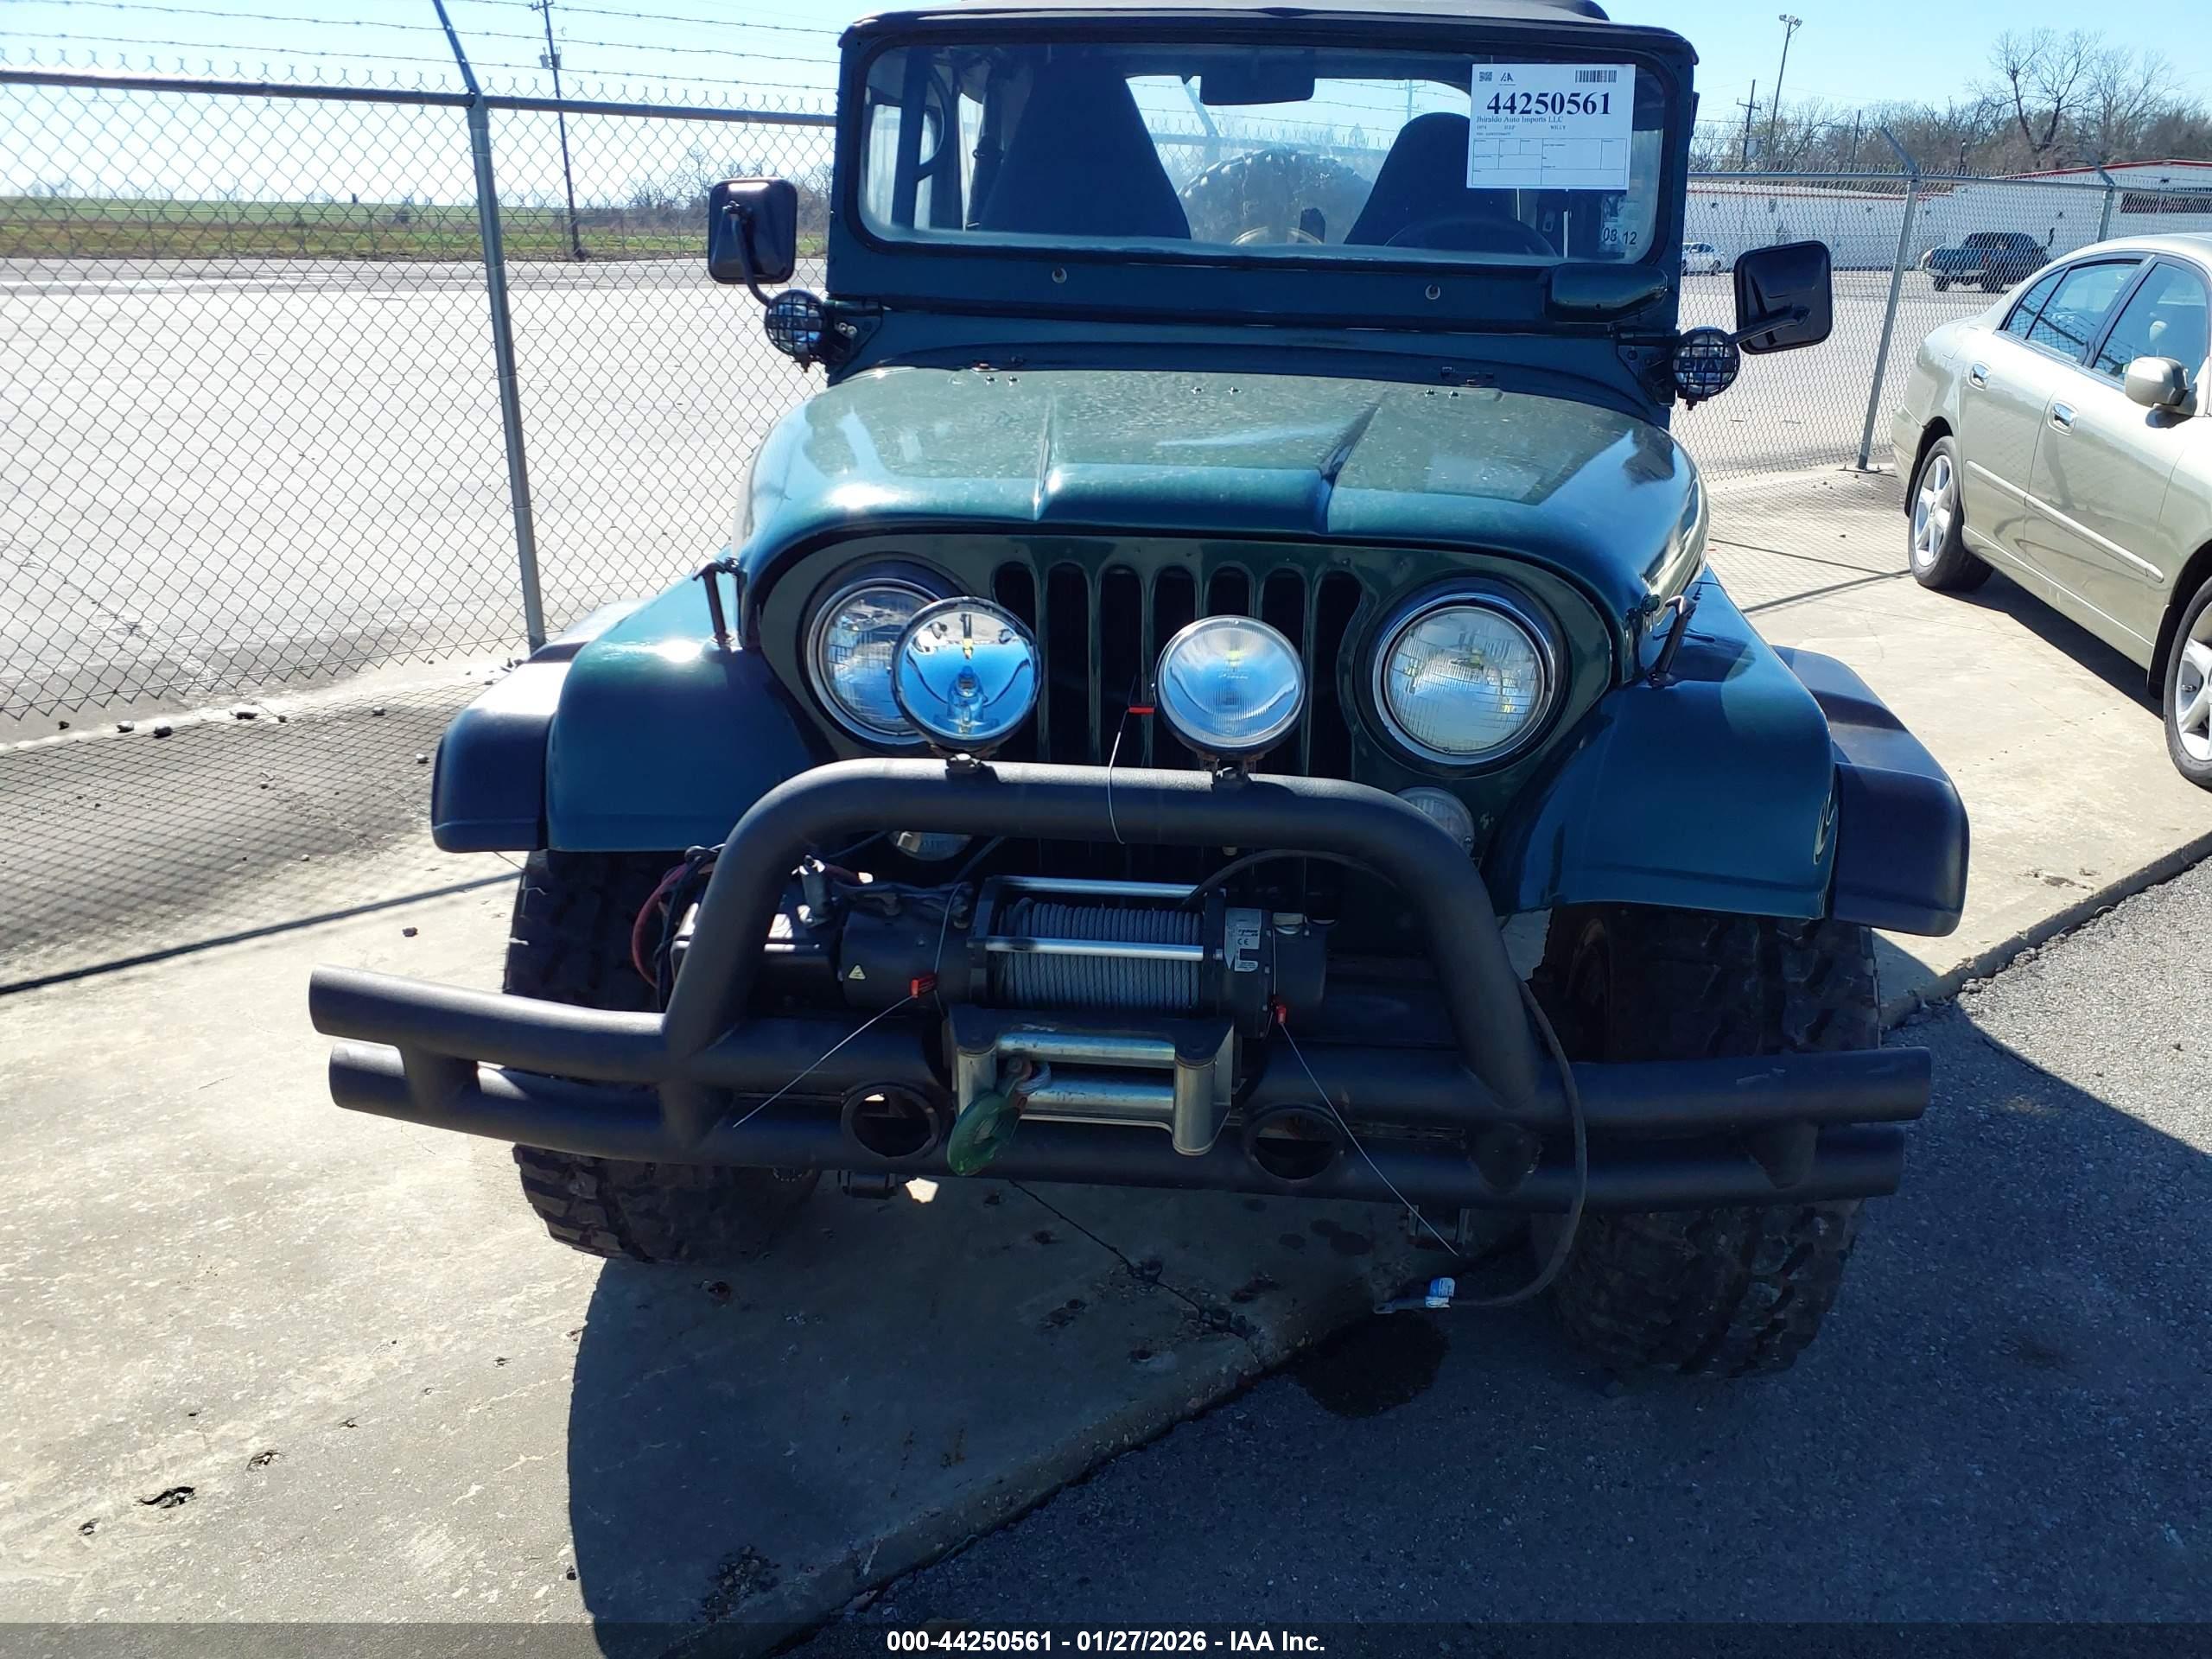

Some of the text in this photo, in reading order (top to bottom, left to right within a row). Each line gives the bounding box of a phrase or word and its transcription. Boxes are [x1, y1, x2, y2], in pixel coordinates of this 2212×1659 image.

[1487, 92, 1611, 115] 44250561
[1522, 116, 1546, 124] Imports
[1624, 231, 1637, 245] 12
